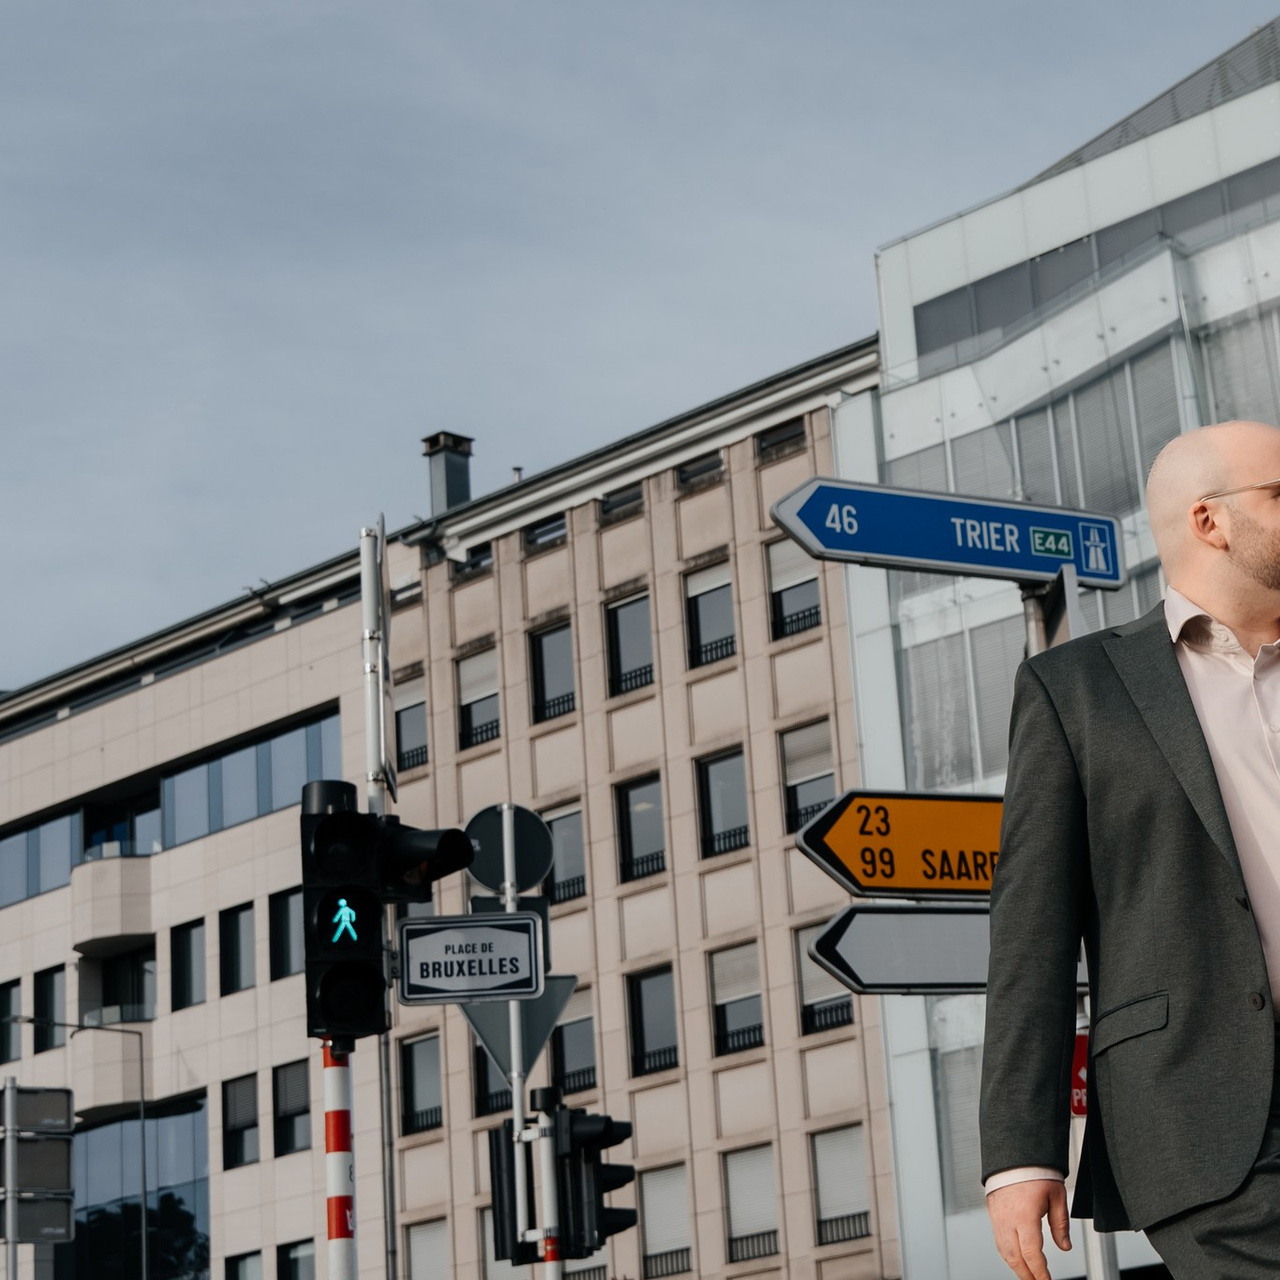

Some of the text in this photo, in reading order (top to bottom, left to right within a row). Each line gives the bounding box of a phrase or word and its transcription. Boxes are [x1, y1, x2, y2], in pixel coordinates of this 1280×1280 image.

[825, 503, 1069, 553] 46 TRIER E44
[857, 805, 890, 836] 23
[860, 847, 895, 879] 99
[445, 942, 494, 955] PLACE DE
[420, 957, 520, 979] BRUXELLES
